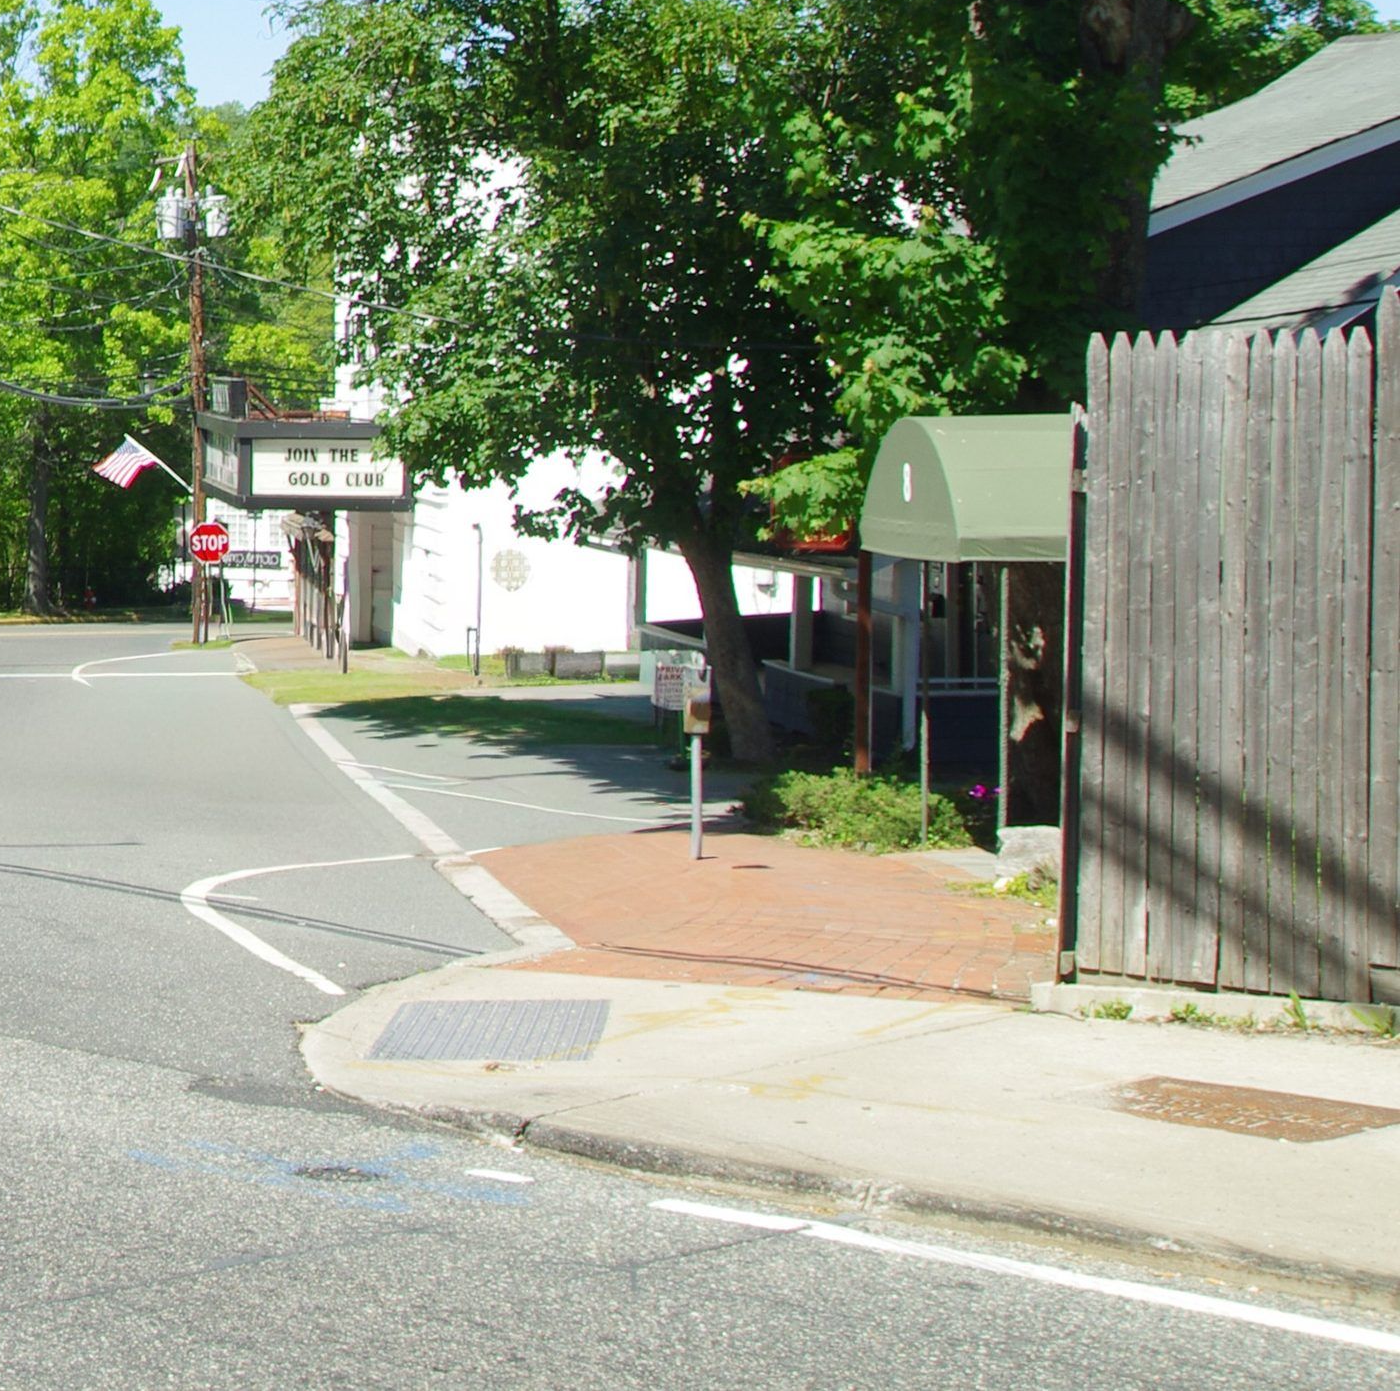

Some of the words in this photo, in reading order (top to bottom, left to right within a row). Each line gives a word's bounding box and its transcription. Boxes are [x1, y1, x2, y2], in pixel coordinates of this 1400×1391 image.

[284, 447, 318, 463] JOIN
[329, 448, 358, 463] THE
[288, 472, 330, 486] GOLD
[346, 472, 384, 487] CLUB
[191, 534, 228, 551] STOP
